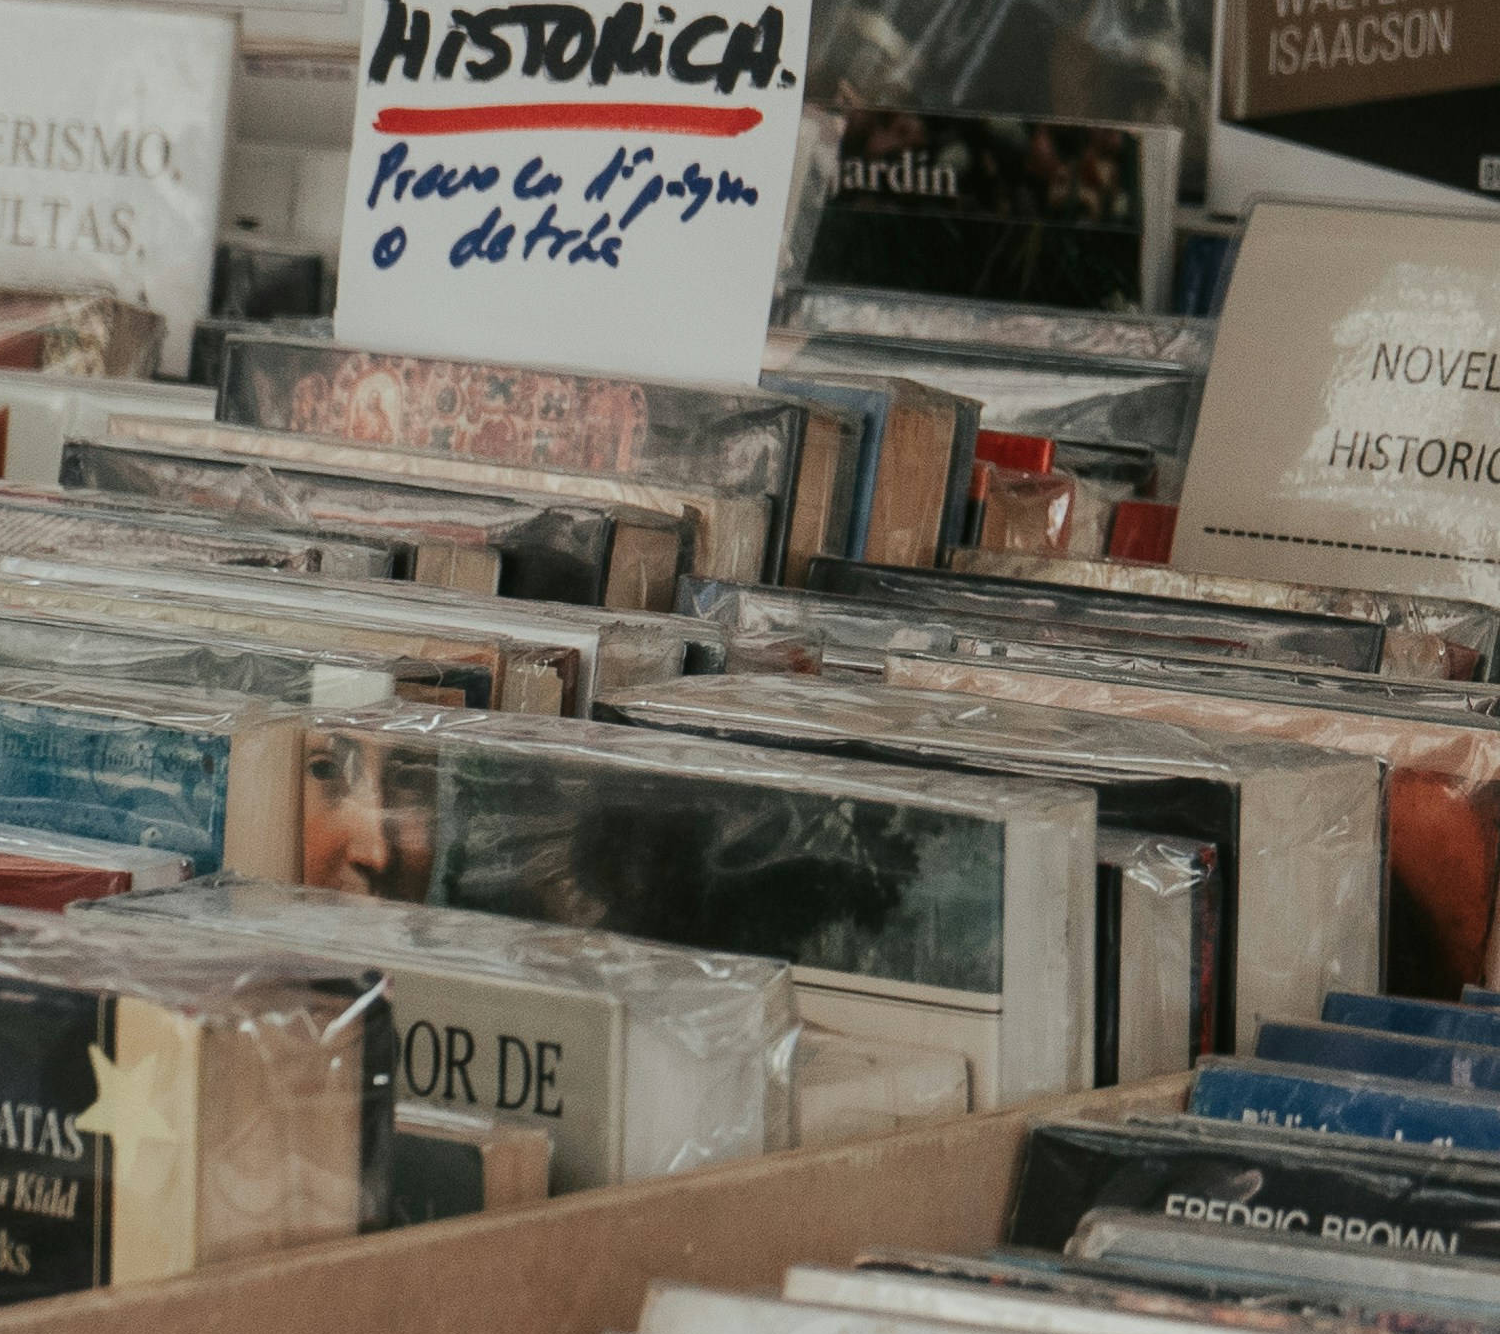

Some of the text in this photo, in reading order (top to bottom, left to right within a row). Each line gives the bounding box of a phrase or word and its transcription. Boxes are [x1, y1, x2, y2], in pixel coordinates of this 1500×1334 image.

[1267, 7, 1454, 77] ISAACSON
[496, 1038, 565, 1121] DE
[13, 1168, 78, 1223] Kidd
